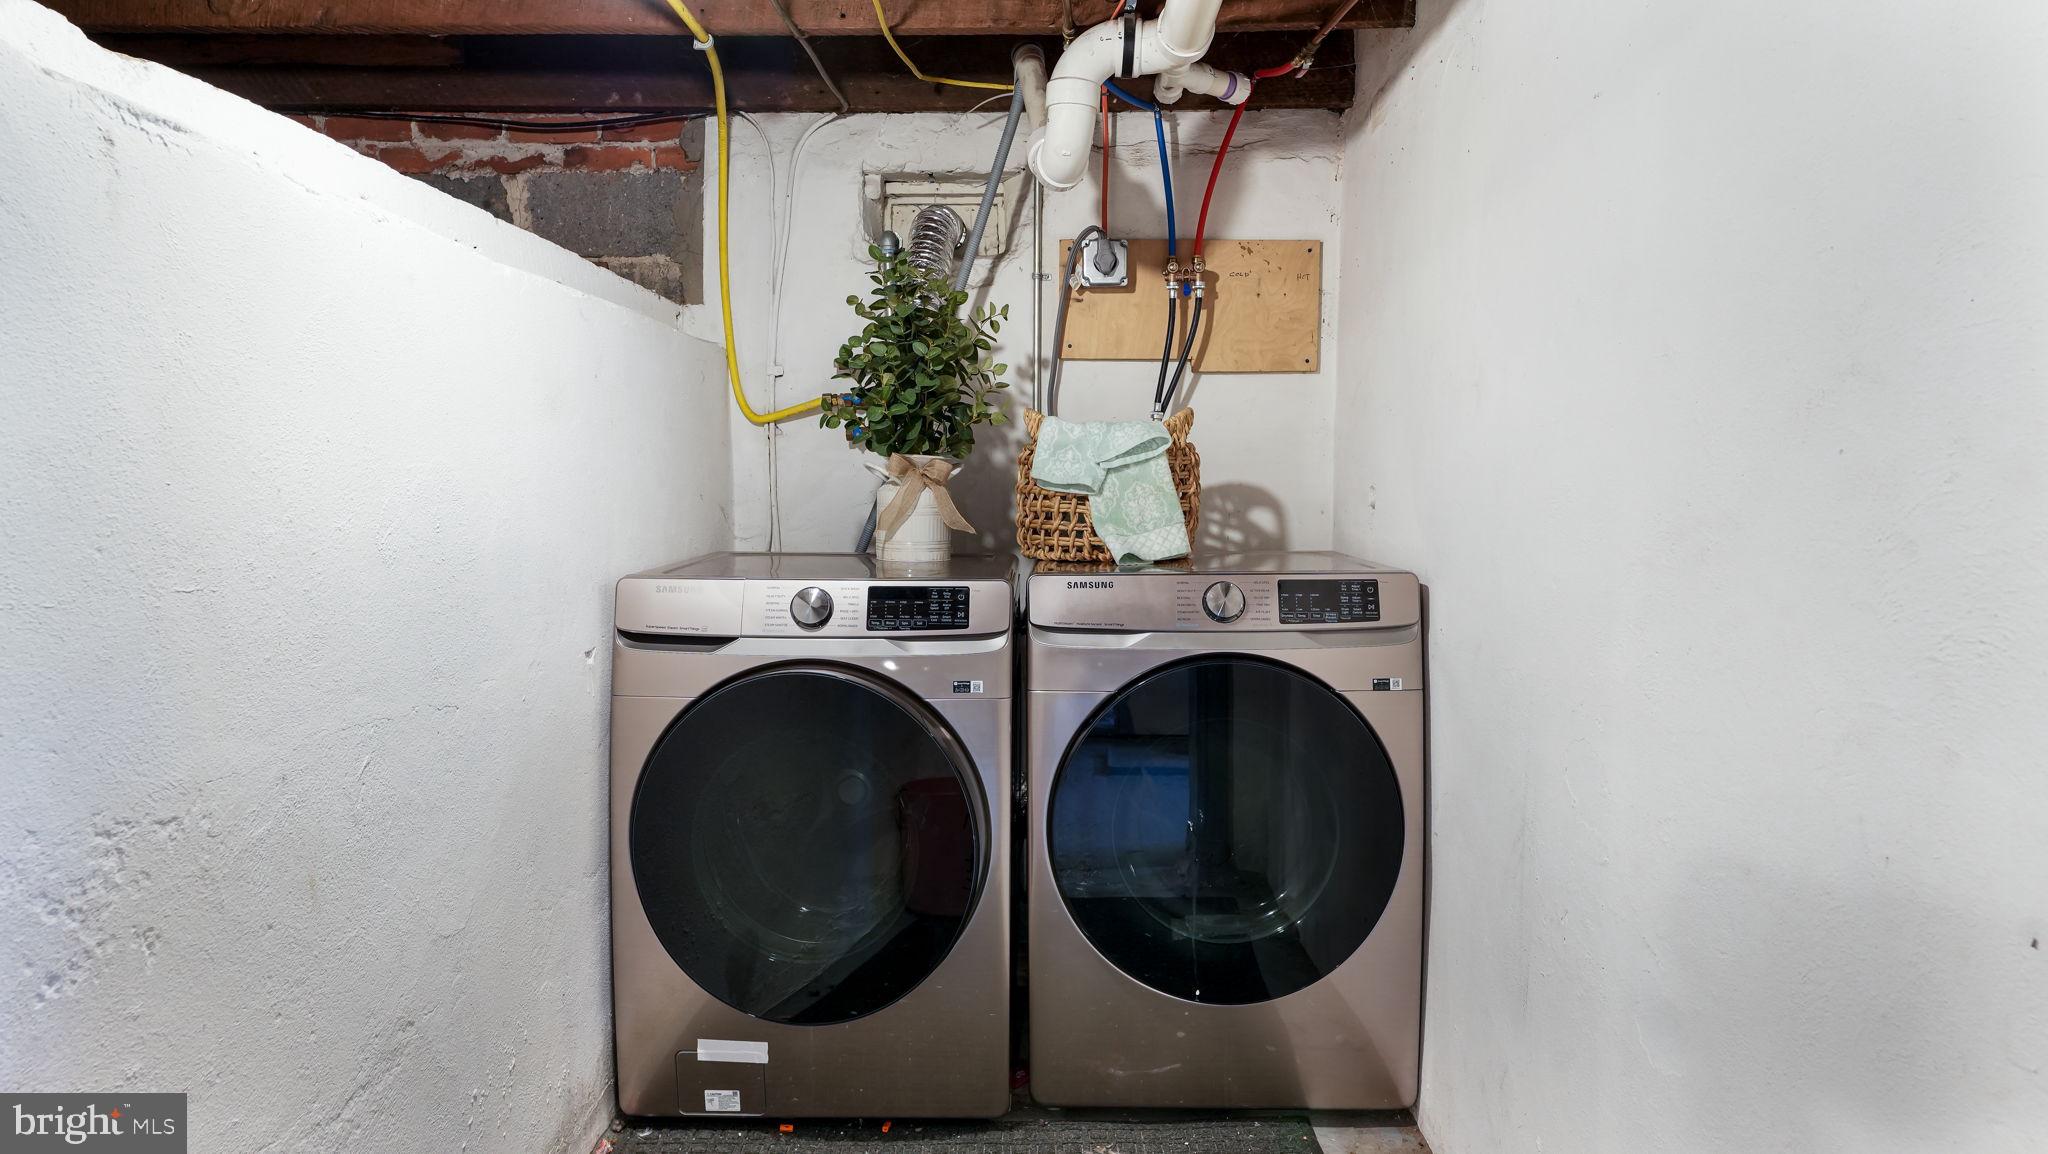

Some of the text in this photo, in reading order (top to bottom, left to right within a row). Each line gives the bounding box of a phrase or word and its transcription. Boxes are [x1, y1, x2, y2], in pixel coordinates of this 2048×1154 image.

[1296, 273, 1311, 281] HOT
[655, 584, 704, 594] SAMSUN
[1066, 581, 1114, 589] SAMSUNG
